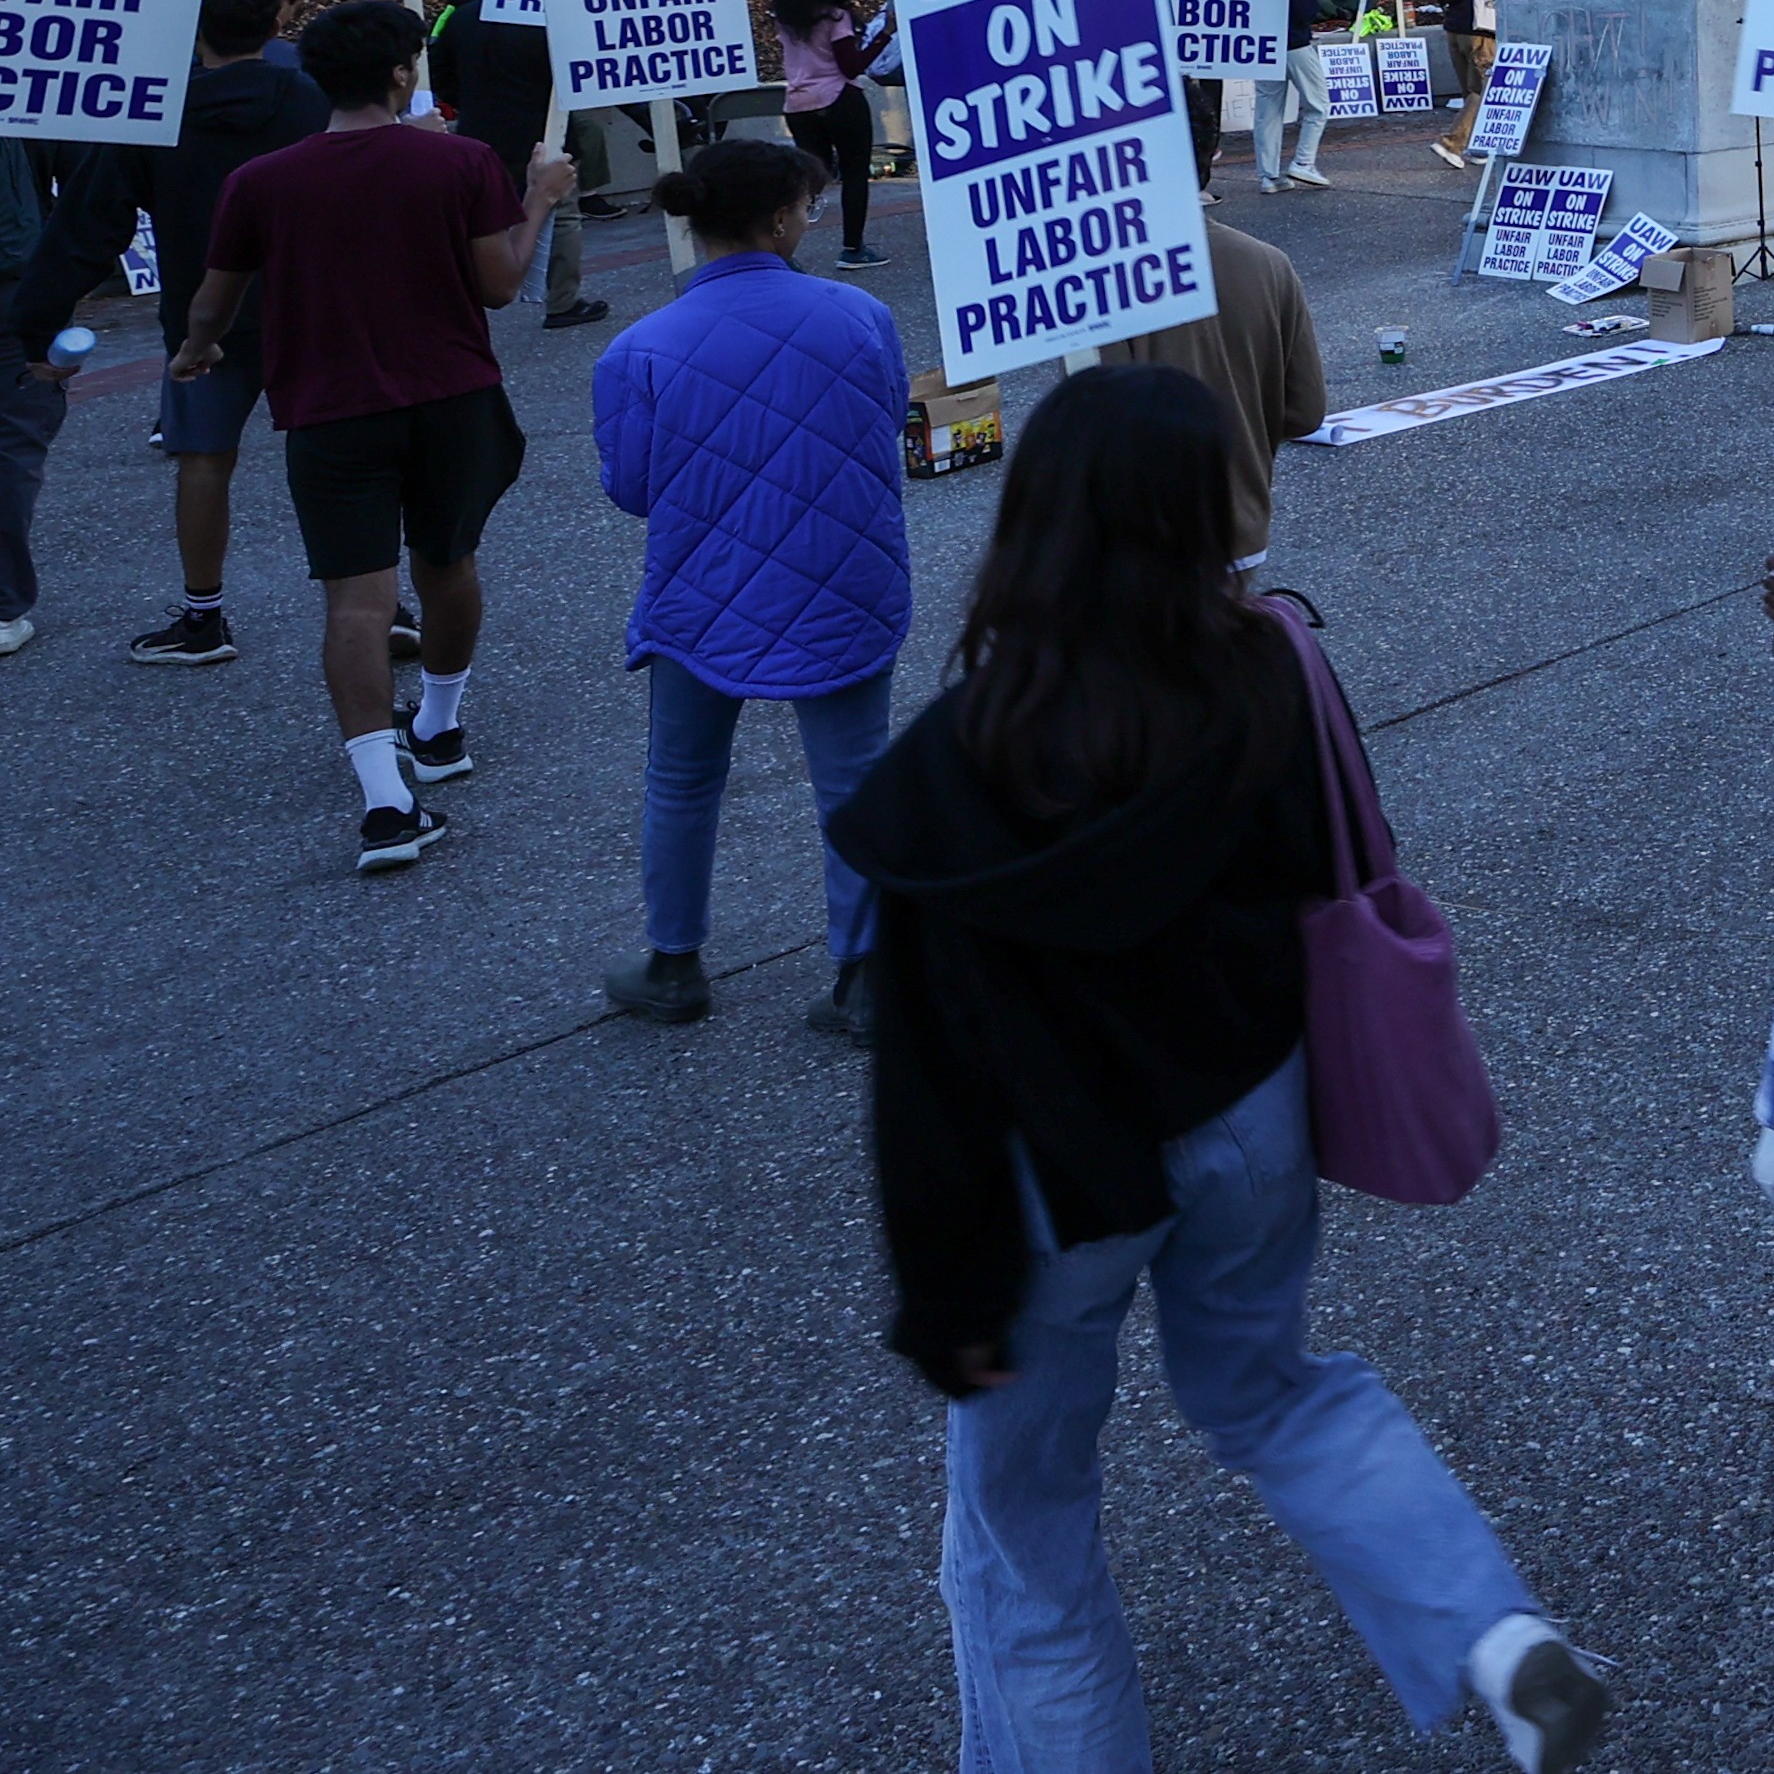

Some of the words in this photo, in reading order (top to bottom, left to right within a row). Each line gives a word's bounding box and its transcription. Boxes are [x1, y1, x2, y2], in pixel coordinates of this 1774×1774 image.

[594, 10, 715, 51] LABOR
[1322, 48, 1365, 57] PRACTICE
[1380, 42, 1422, 50] PRACTICE
[1499, 48, 1547, 65] UAW
[569, 44, 746, 93] PRACTICE
[1384, 71, 1425, 82] STRIKE
[1327, 78, 1369, 89] STRIKE
[1504, 70, 1525, 86] ON
[1341, 89, 1358, 100] ON
[1397, 83, 1415, 93] ON
[1486, 86, 1534, 105] STRIKE
[934, 42, 1164, 160] STRIKE
[1330, 103, 1374, 115] UAW
[1386, 97, 1429, 108] UAW
[1486, 108, 1521, 121] UNFAIR
[1483, 123, 1515, 135] LABOR
[1473, 136, 1520, 150] PRACTICE
[968, 137, 1149, 227] UNFAIR
[1507, 167, 1556, 185] UAW
[1559, 170, 1608, 189] UAW
[1513, 191, 1533, 206] ON
[1566, 194, 1586, 210] ON
[1496, 208, 1542, 226] STRIKE
[1548, 212, 1595, 230] STRIKE
[1496, 230, 1531, 243] UNFAIR
[1549, 233, 1584, 248] UNFAIR
[1629, 216, 1673, 249] UAW
[985, 197, 1148, 285] LABOR
[1494, 244, 1525, 257] LABOR
[1547, 248, 1579, 261] LABOR
[1623, 242, 1645, 260] ON
[1484, 257, 1530, 273] PRACTICE
[1601, 251, 1638, 282] STRIKE
[956, 244, 1197, 354] PRACTICE
